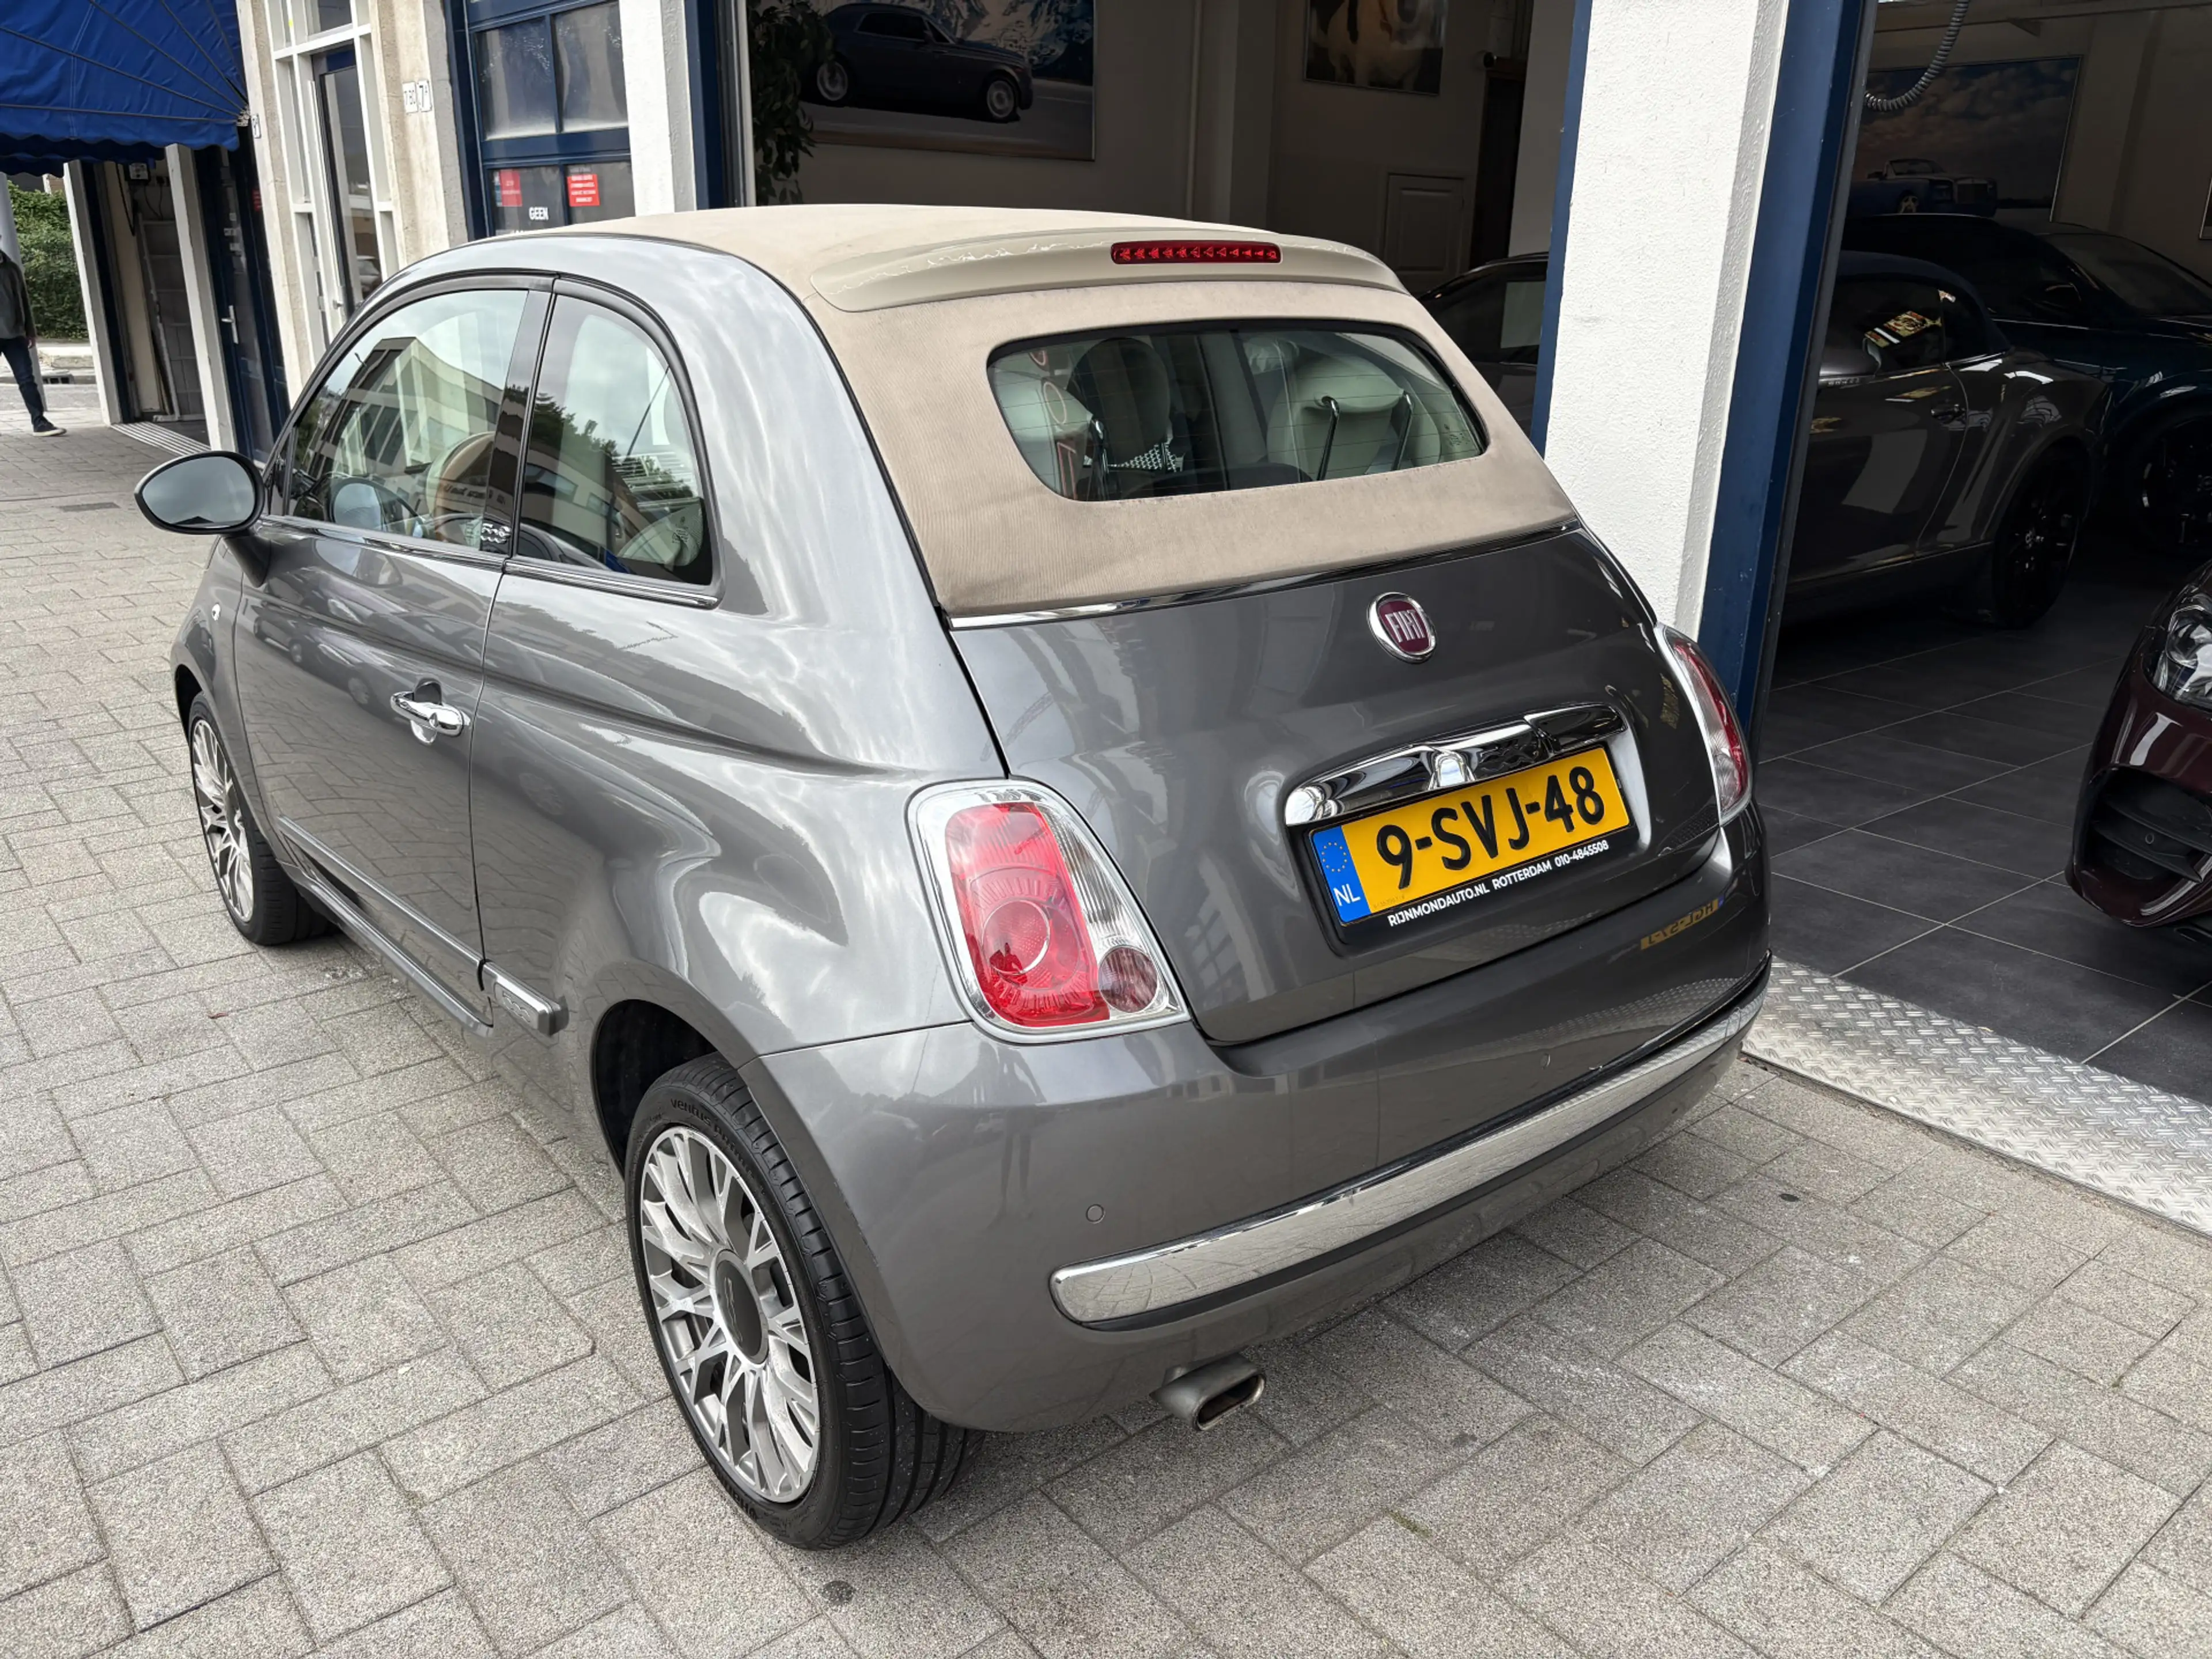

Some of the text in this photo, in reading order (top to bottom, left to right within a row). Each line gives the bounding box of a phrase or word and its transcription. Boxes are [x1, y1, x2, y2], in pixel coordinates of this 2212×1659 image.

[529, 207, 549, 220] GEEN
[1385, 609, 1425, 643] FIAT
[1376, 766, 1605, 890] 9-SVJ-48
[1334, 884, 1361, 907] NL
[1387, 882, 1490, 927] RIJNMONDAUTO.NL
[1491, 859, 1552, 890] ROTTERDAM
[1554, 839, 1609, 868] 010-4845508
